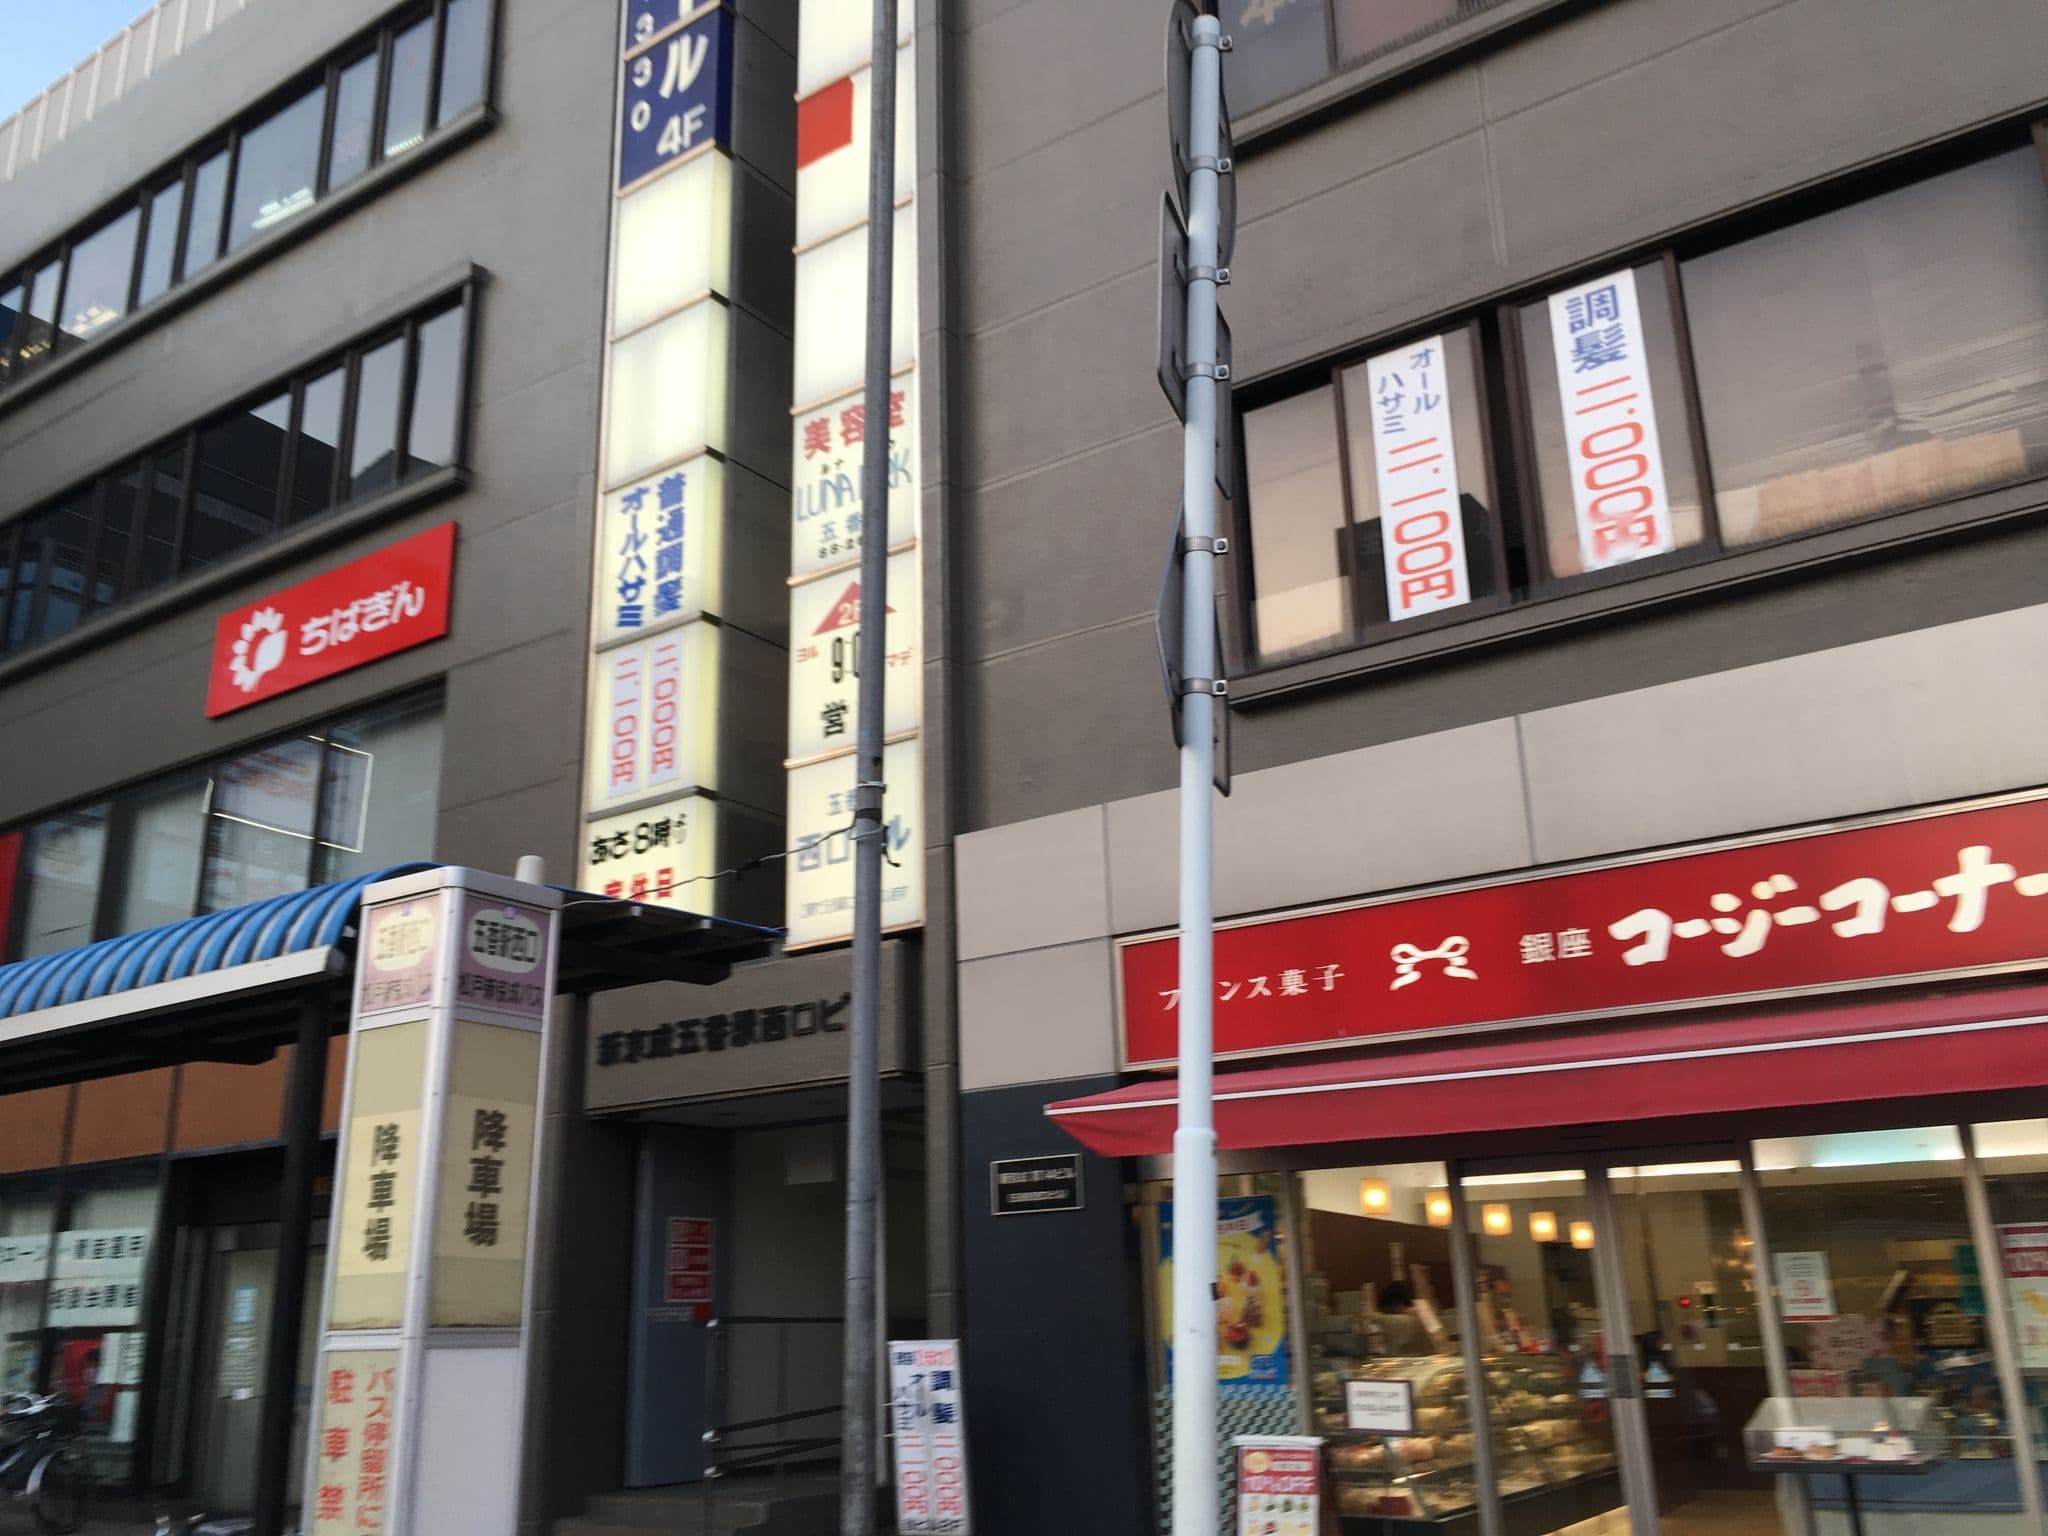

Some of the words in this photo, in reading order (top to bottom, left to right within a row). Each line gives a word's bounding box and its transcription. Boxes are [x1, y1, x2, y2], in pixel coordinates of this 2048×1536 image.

[656, 103, 706, 157] 4F
[616, 486, 650, 627] オールハサミ
[299, 580, 425, 656] ちばぎん
[796, 815, 911, 873] 西口ル
[1519, 928, 1594, 964] 銀座
[1159, 963, 1345, 1011] フンス菓子
[362, 1122, 399, 1262] 降車場
[463, 1109, 508, 1247] 降車場
